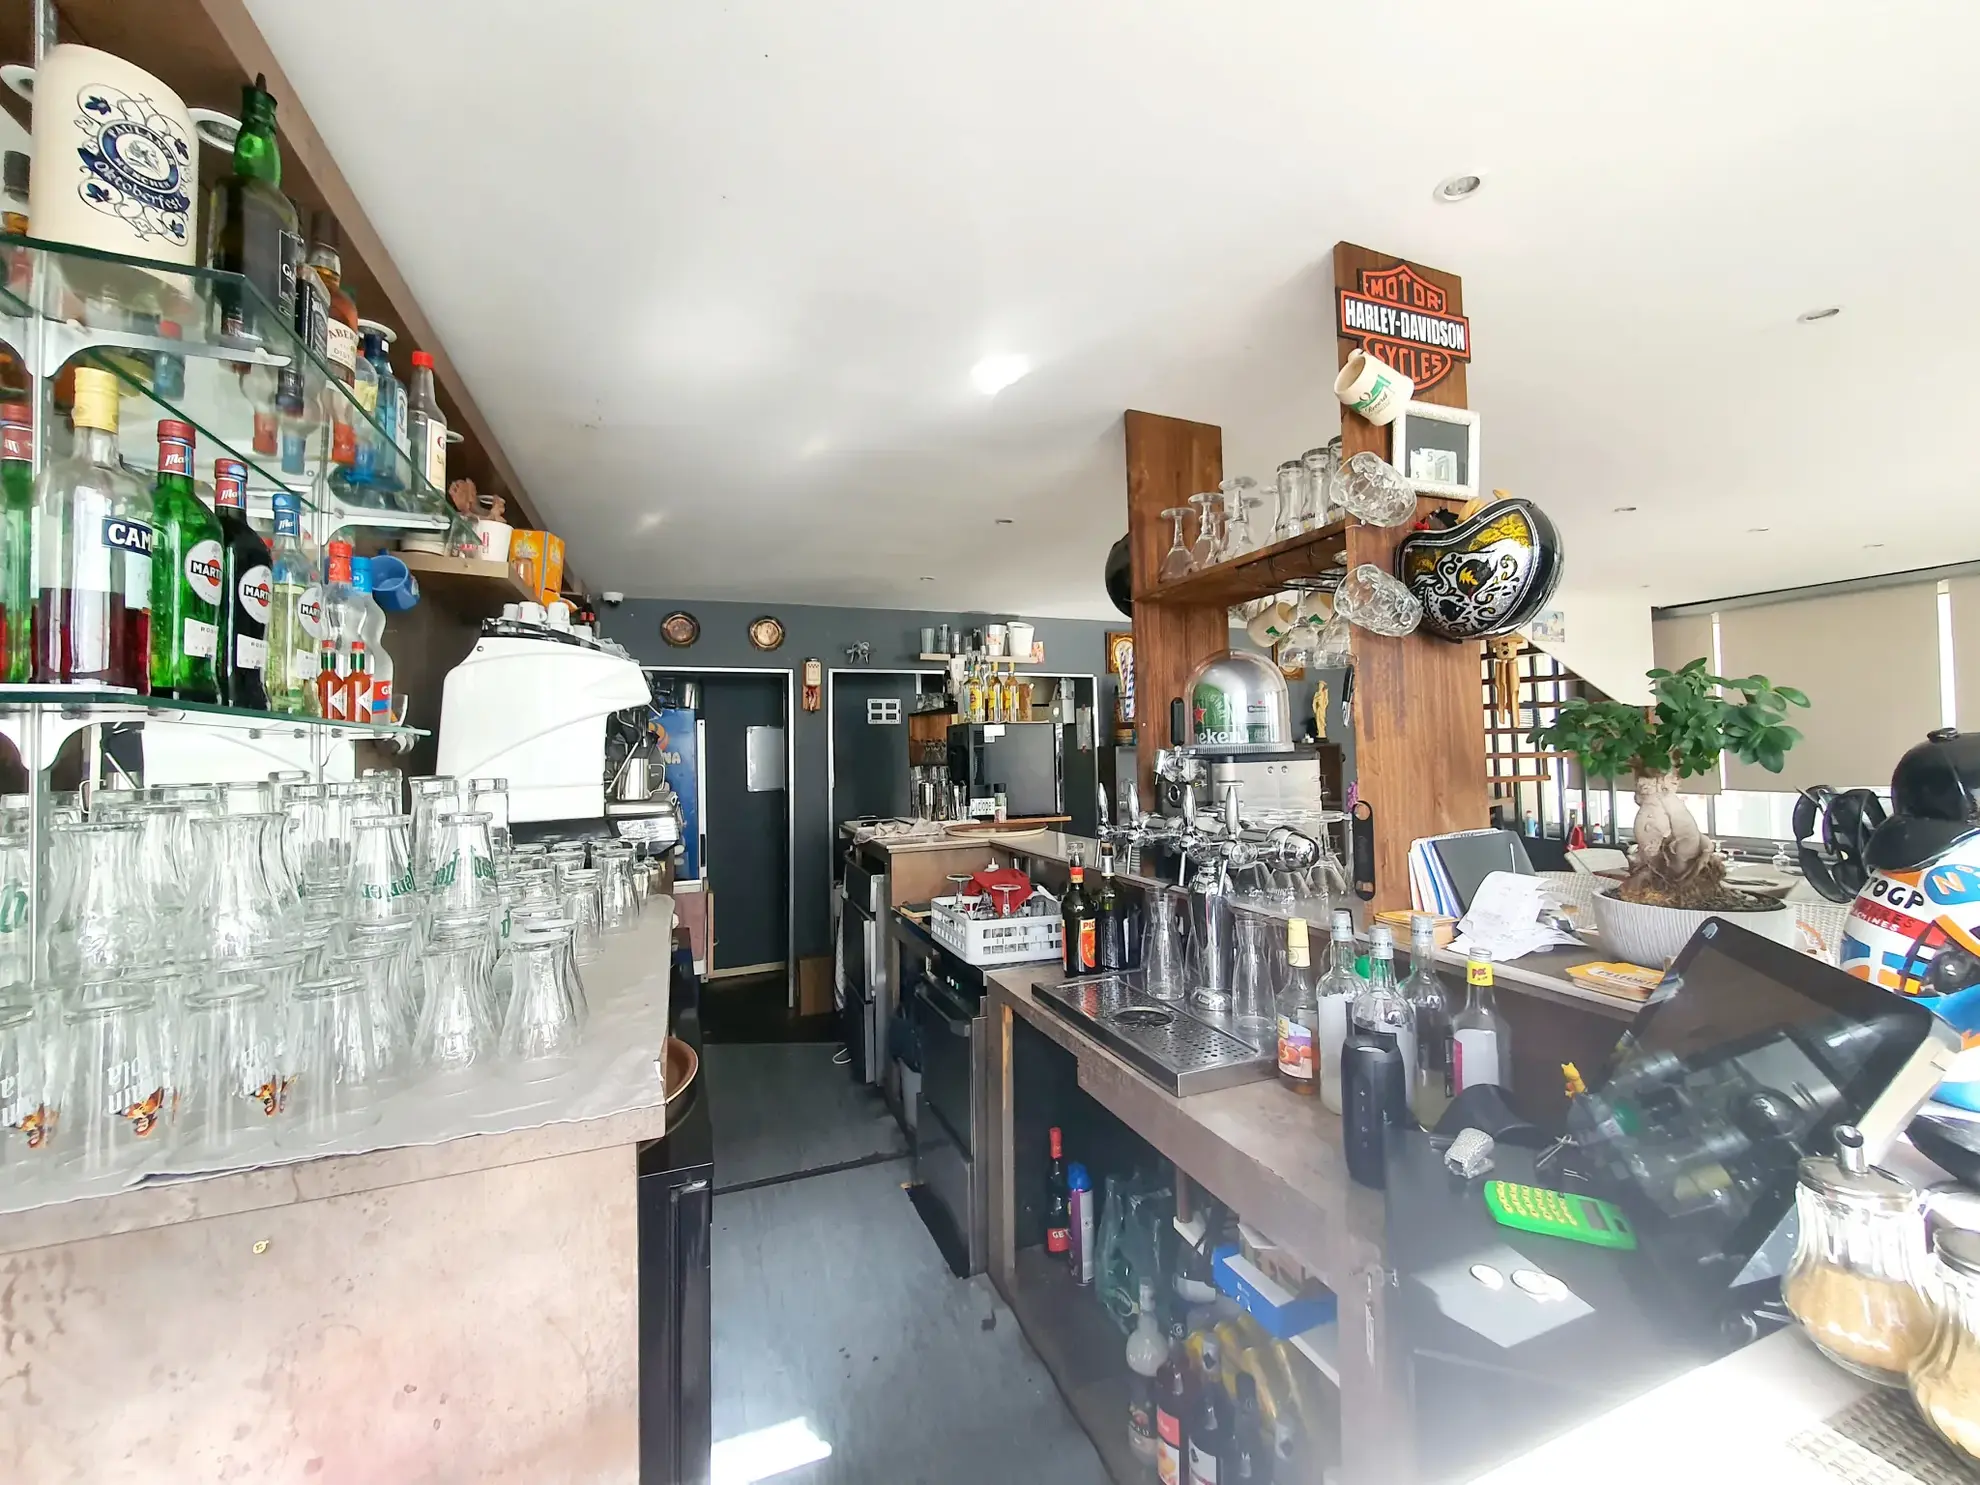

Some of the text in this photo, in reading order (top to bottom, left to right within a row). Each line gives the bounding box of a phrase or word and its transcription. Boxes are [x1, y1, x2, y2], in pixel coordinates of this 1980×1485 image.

[1371, 273, 1439, 310] MOTOR
[1345, 298, 1465, 350] HARLEY-DAVIDSON
[192, 561, 221, 578] MART
[1864, 877, 1924, 909] TOGP
